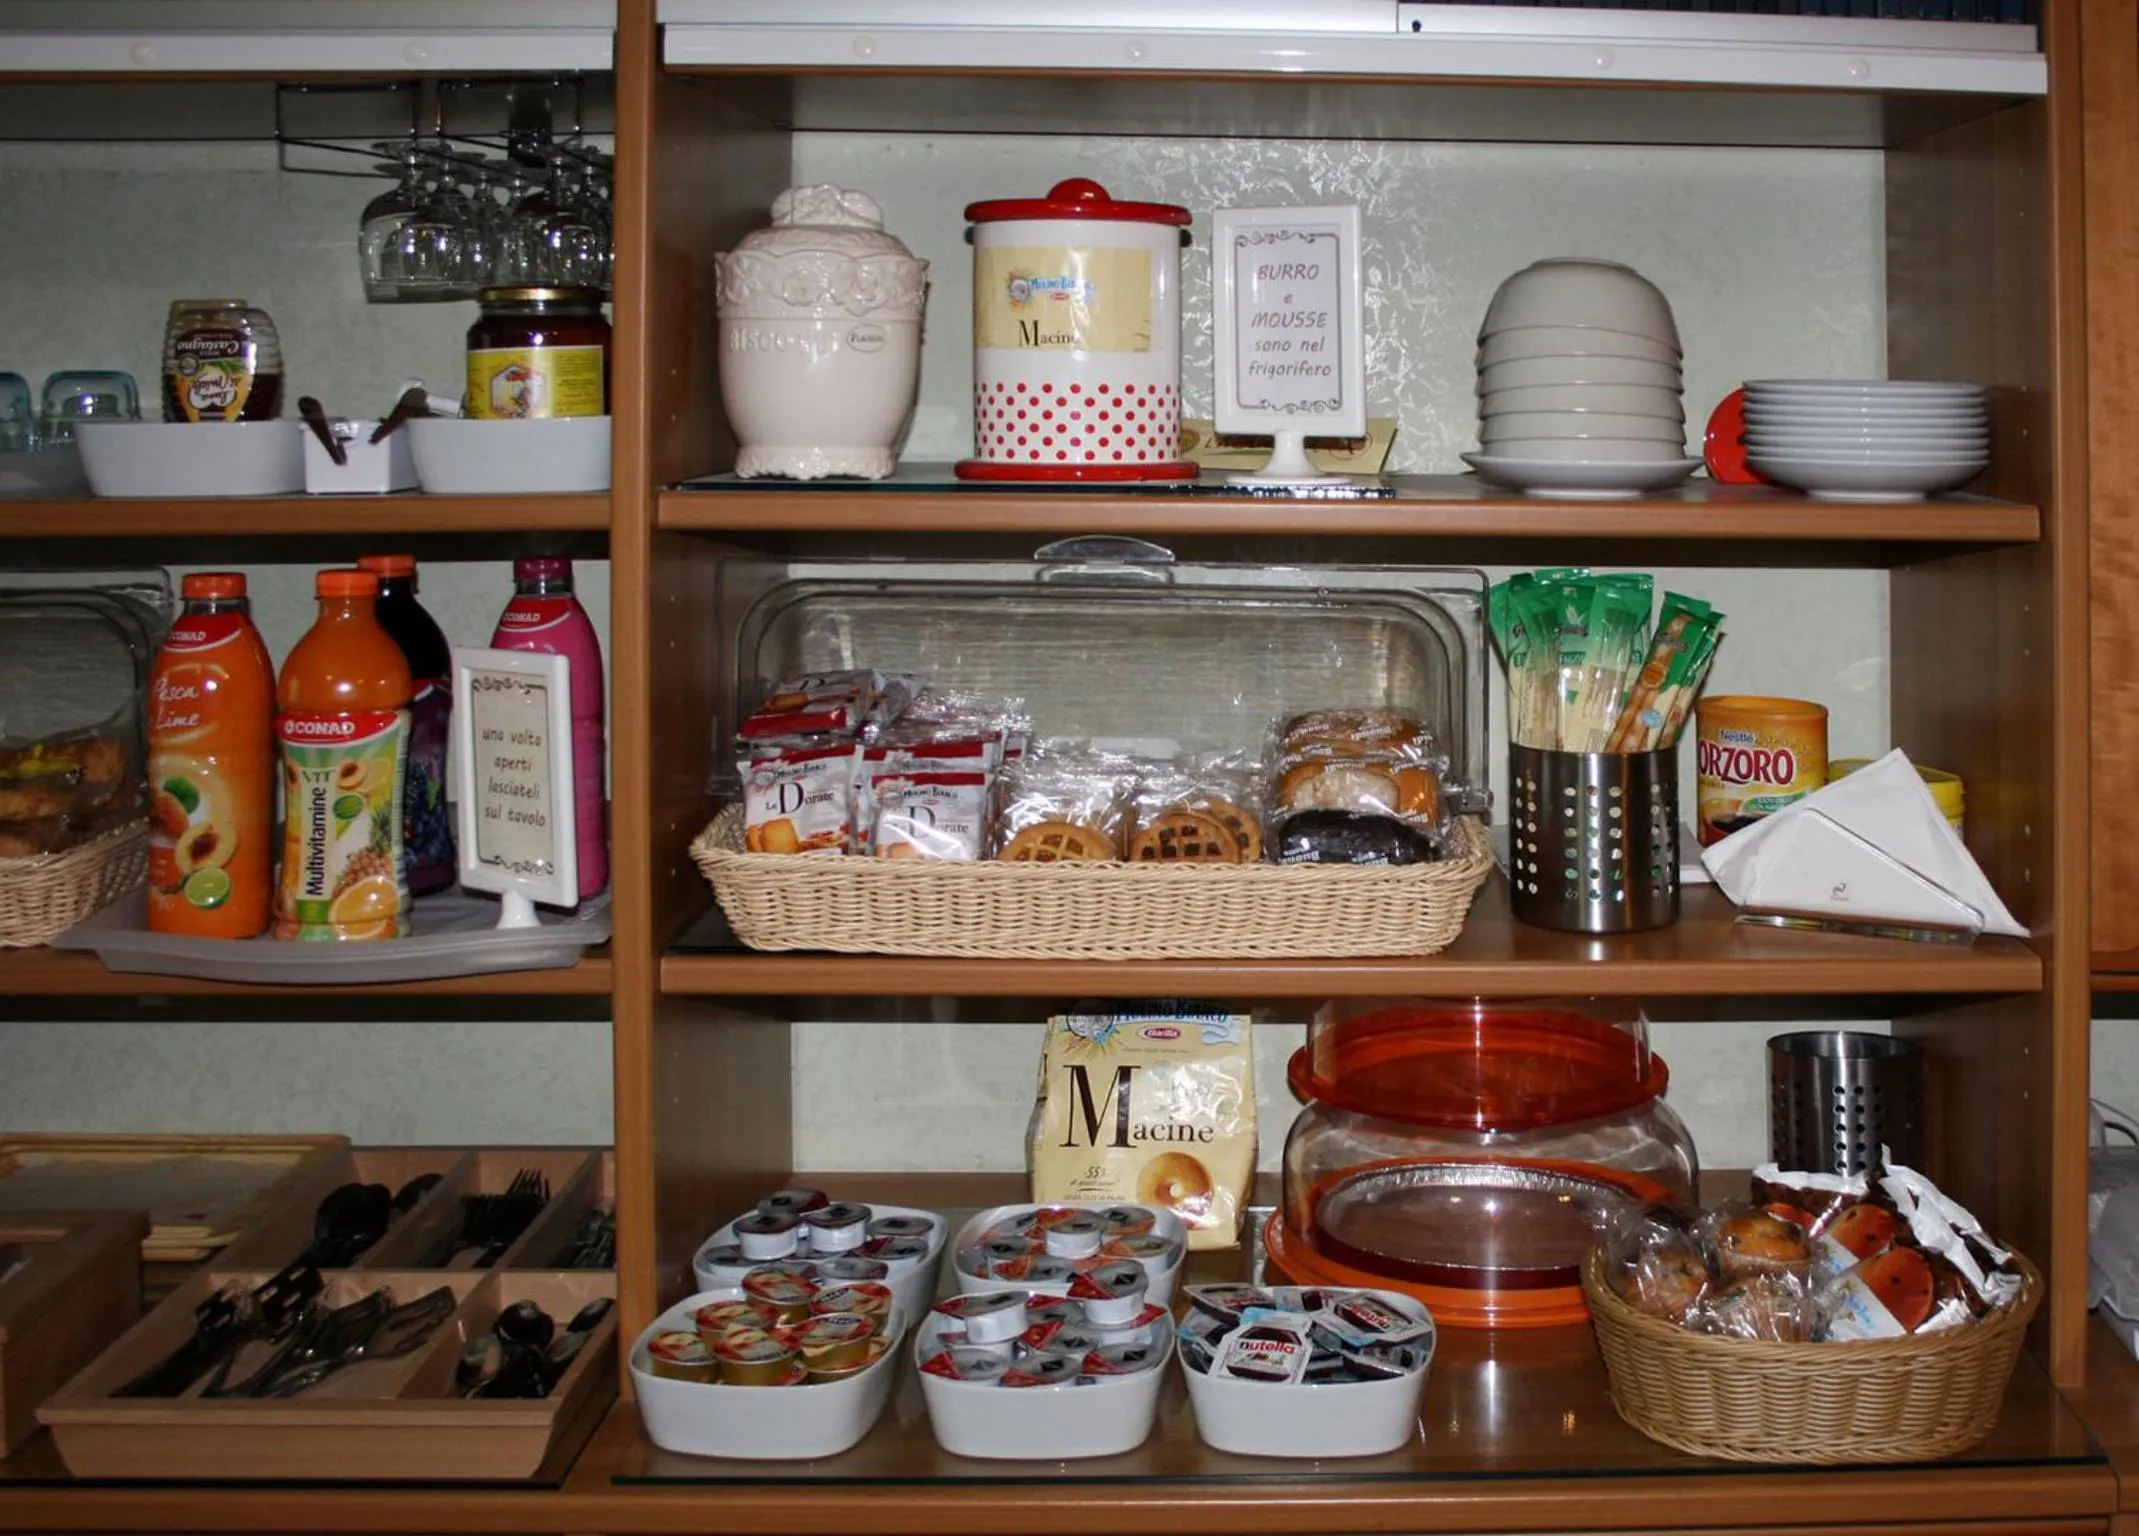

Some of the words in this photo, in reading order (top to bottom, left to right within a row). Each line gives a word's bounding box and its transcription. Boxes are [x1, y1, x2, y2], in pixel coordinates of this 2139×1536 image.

[1257, 263, 1320, 281] BURRO
[1283, 293, 1294, 305] e
[1251, 311, 1328, 329] MOUSSE
[178, 337, 239, 354] Castagno
[1254, 339, 1291, 352] sono
[1300, 335, 1326, 352] nel
[1249, 360, 1332, 380] frigorifero
[295, 720, 356, 735] CONAD
[482, 729, 504, 742] una
[511, 728, 542, 747] volta
[493, 755, 533, 773] aperti
[1698, 739, 1795, 786] ORZORO
[488, 776, 540, 800] lasciateli
[779, 781, 835, 814] Dorate
[484, 803, 502, 820] sul
[508, 807, 547, 828] tavolo
[304, 786, 328, 896] Multivitamine
[1058, 1065, 1215, 1149] Macine
[1240, 1340, 1296, 1355] nutella
